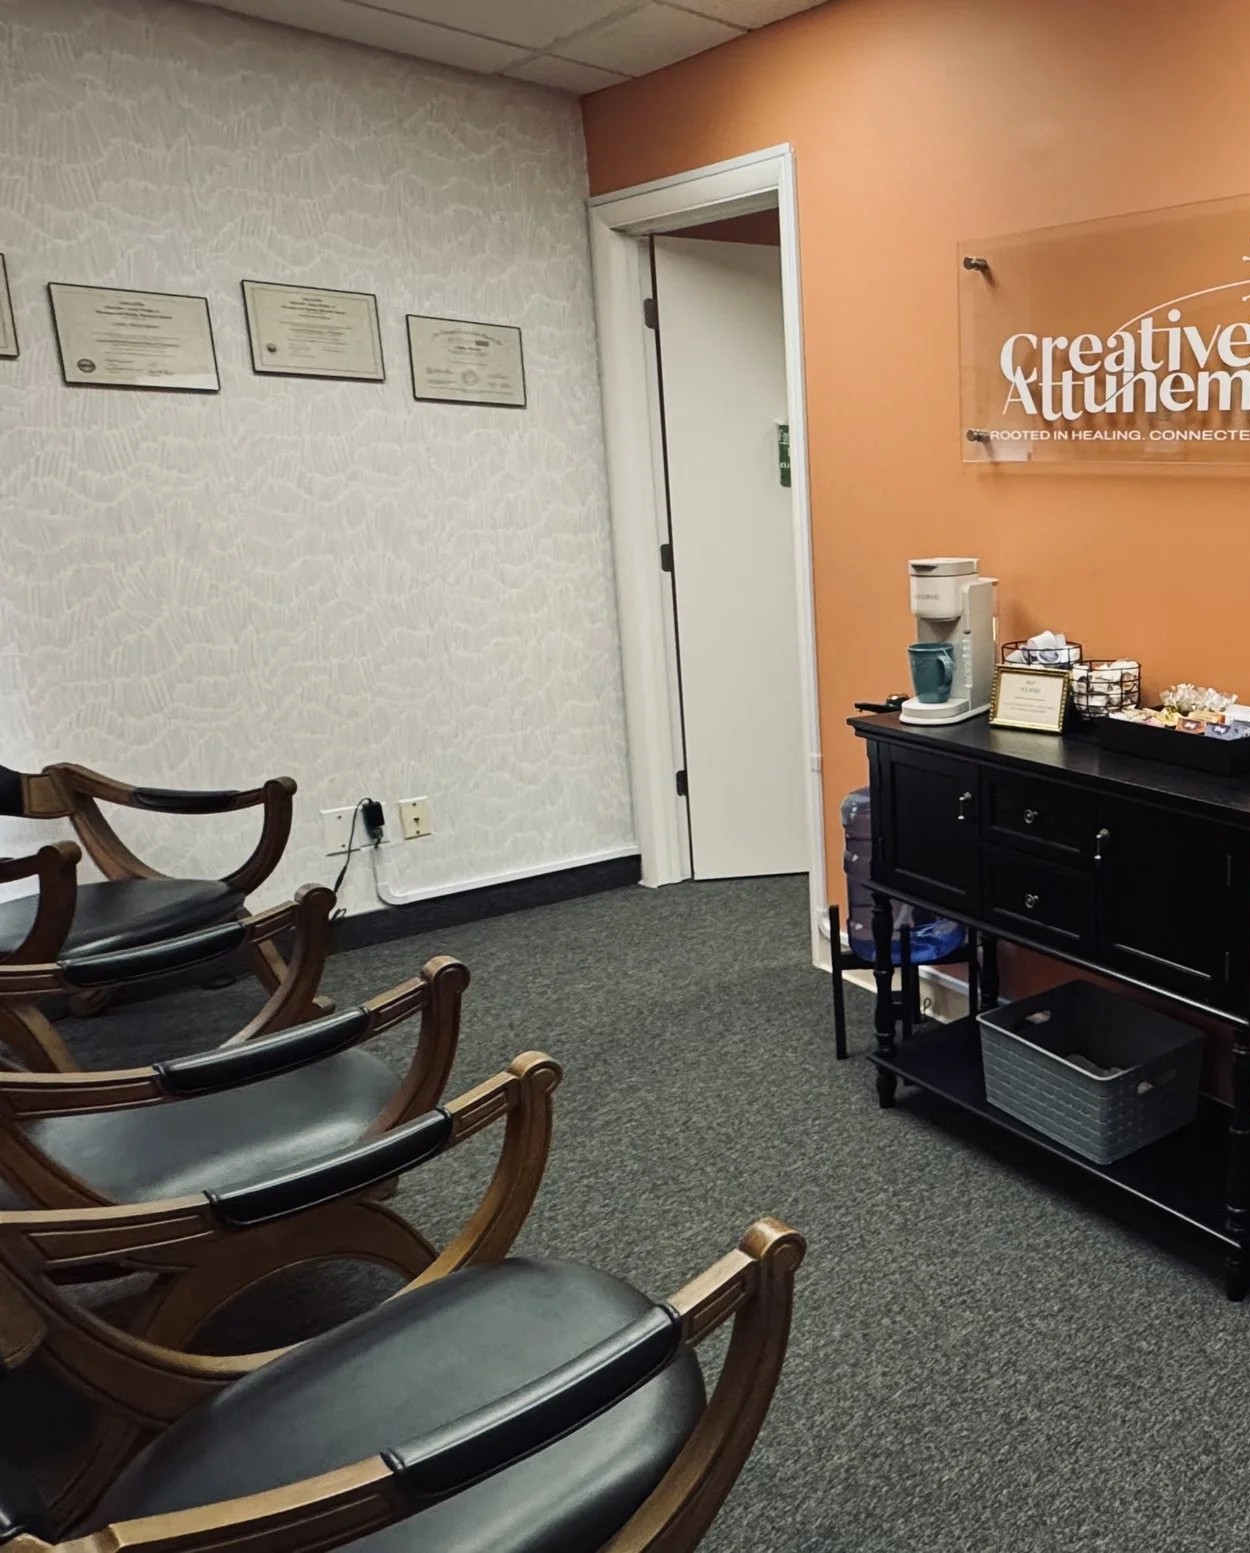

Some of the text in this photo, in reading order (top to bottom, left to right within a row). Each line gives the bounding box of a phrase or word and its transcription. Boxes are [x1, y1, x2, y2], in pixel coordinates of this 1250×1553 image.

[990, 429, 1050, 441] ROOTED
[1053, 430, 1068, 441] IN
[1071, 430, 1146, 441] HEALING.
